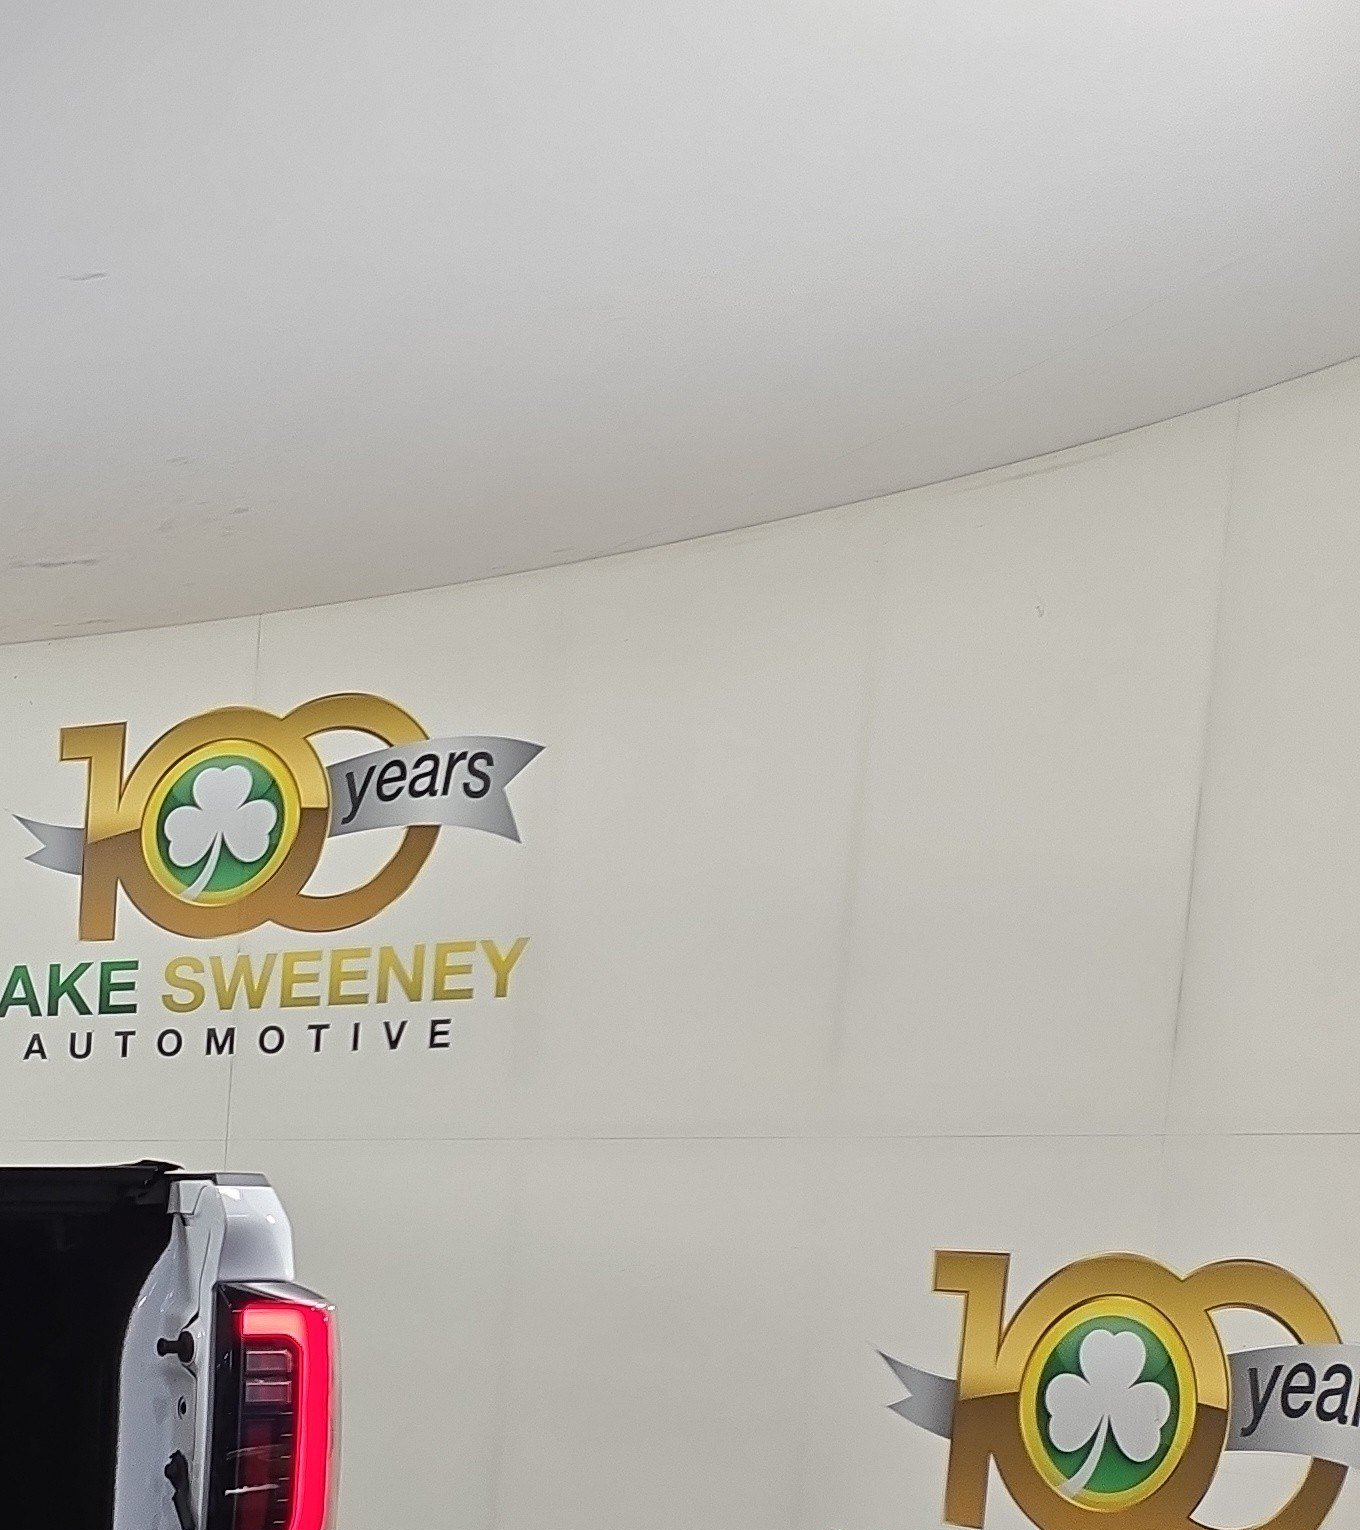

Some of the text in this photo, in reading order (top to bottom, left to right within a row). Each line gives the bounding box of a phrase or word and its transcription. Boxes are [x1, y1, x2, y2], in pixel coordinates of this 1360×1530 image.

[340, 747, 496, 826] years
[161, 937, 530, 1014] SWEENEY
[23, 1019, 453, 1060] AUTOMOTIVE
[1240, 1362, 1360, 1437] yea
